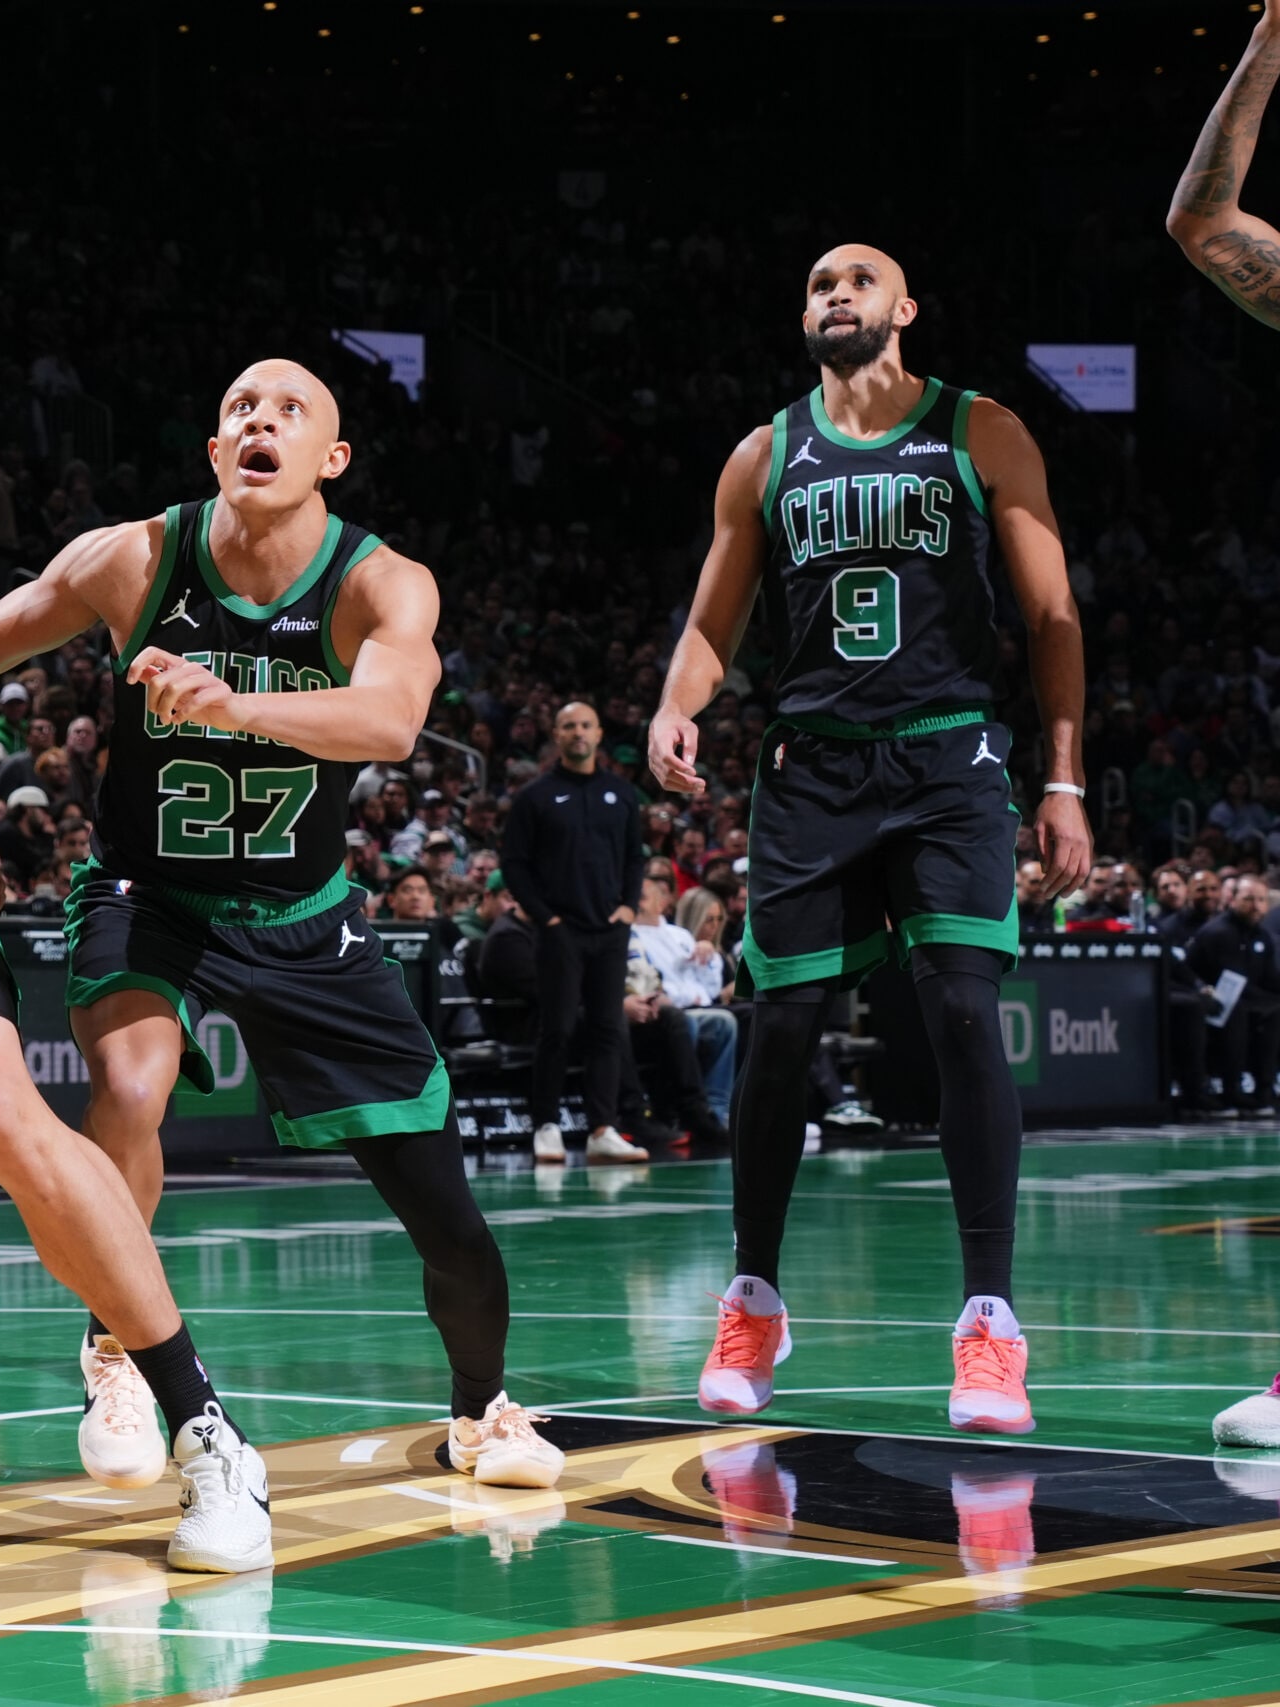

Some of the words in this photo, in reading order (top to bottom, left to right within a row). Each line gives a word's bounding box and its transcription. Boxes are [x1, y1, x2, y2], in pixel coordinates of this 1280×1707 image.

[899, 442, 949, 457] Amica
[781, 472, 953, 567] CELTICS
[271, 616, 320, 632] Amica
[831, 566, 901, 662] 9
[157, 759, 318, 859] 27
[1049, 1007, 1119, 1054] Bank
